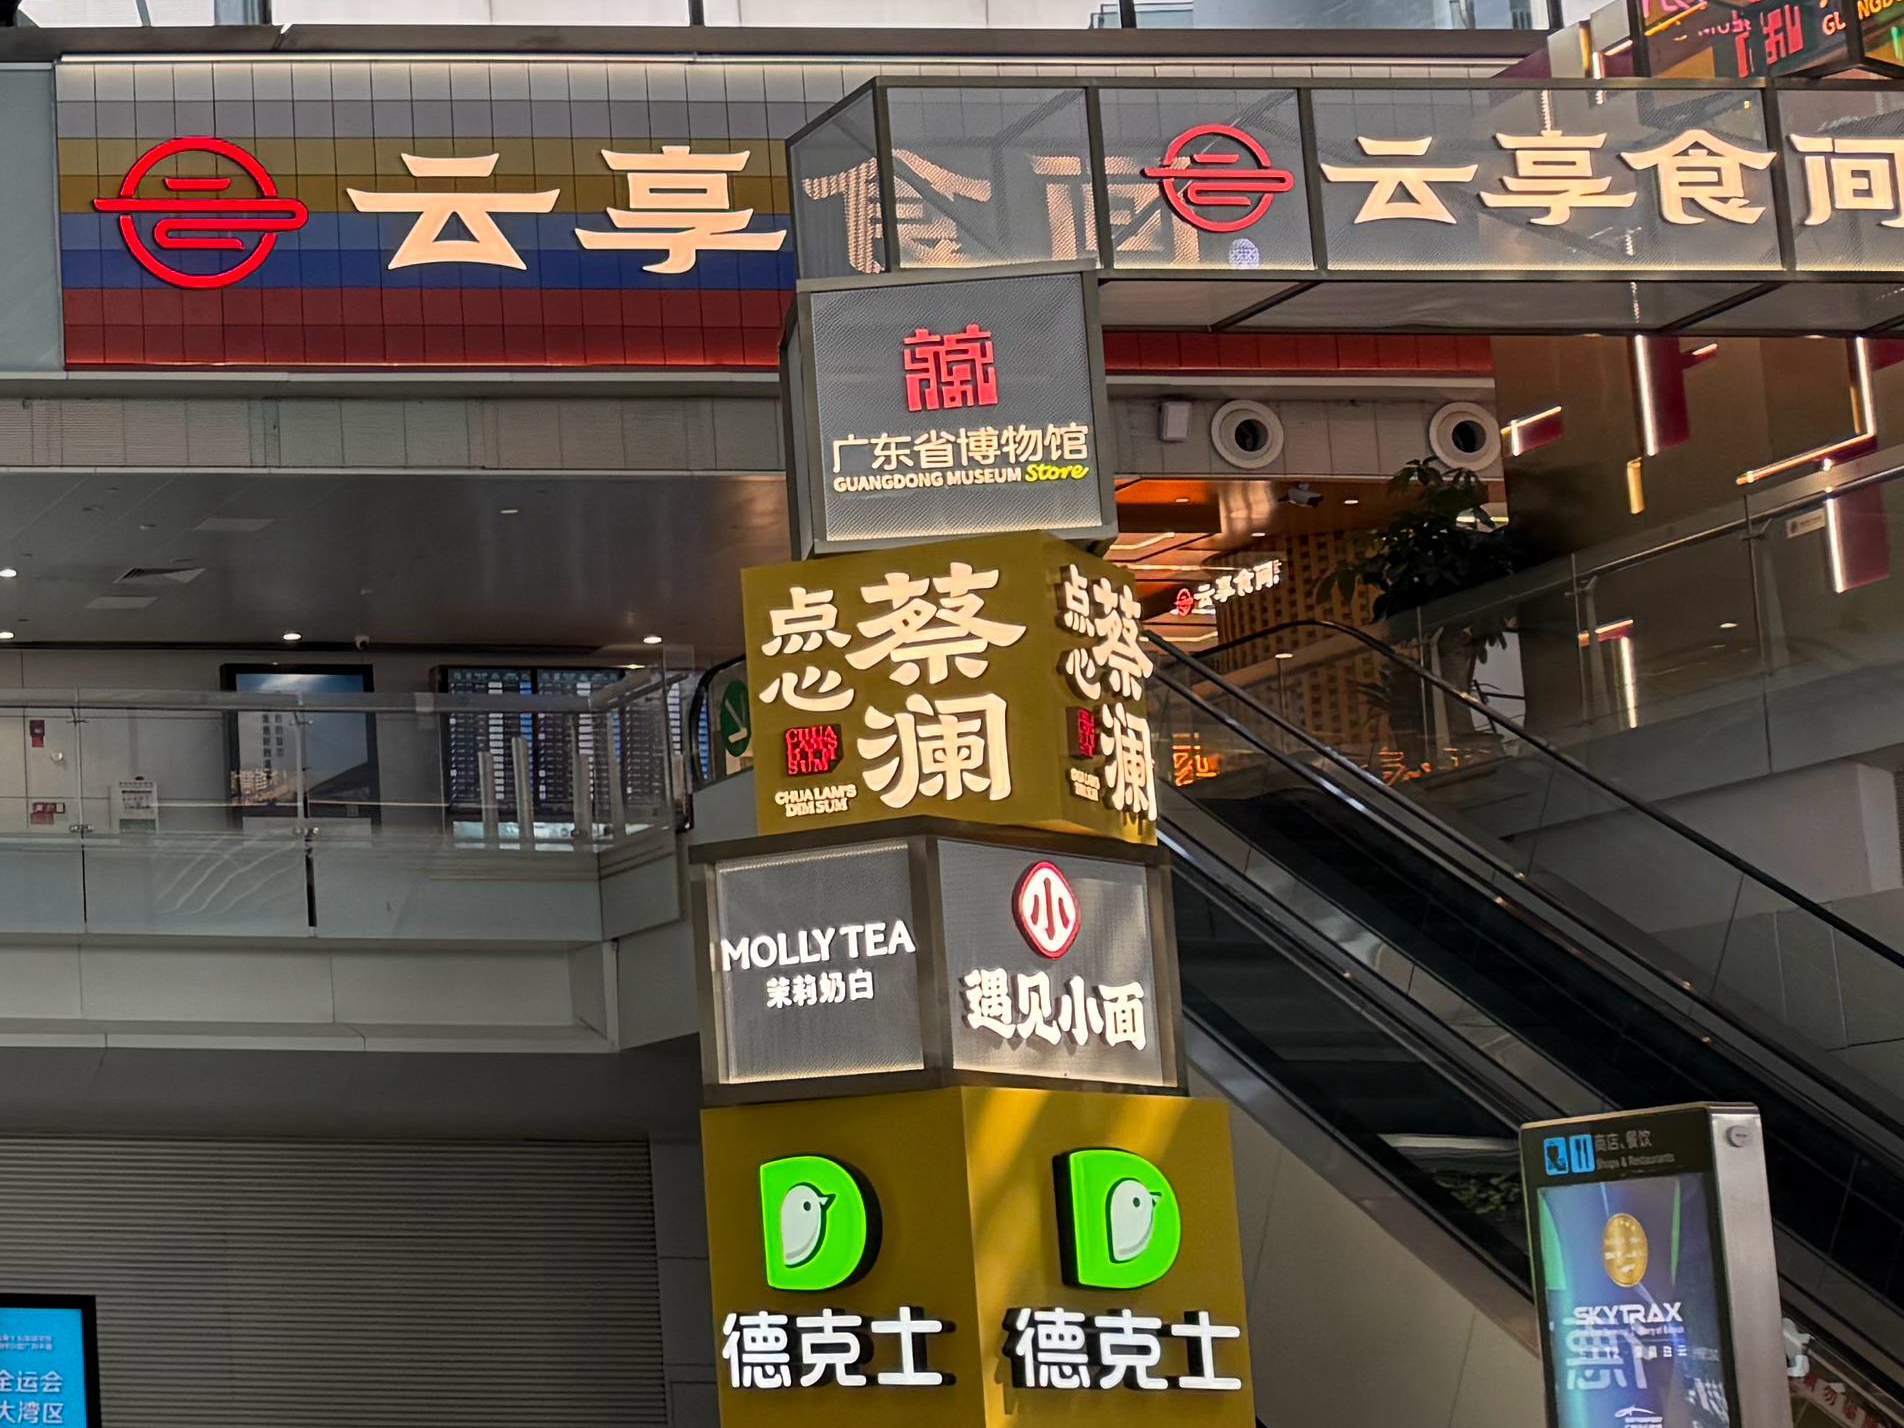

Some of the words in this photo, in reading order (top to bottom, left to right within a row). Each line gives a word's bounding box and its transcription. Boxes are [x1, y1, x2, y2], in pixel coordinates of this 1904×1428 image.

[1320, 128, 1904, 228] 云享食间
[832, 422, 1089, 474] 广东省博物馆
[832, 471, 944, 493] GUANGDONG
[946, 467, 1022, 487] MUSEUM
[1024, 463, 1090, 484] Store
[758, 586, 855, 712] 点心
[844, 561, 1027, 809] 蔡澜
[1091, 576, 1158, 822] 蔡澜
[720, 928, 849, 972] MOLLY
[838, 919, 917, 959] TEA
[766, 969, 875, 1010] 茉莉奶白
[962, 966, 1147, 1051] 遇见小面
[721, 1305, 944, 1390] 德克士
[1015, 1306, 1243, 1391] 德克士
[1572, 1301, 1684, 1325] SKYTRAX
